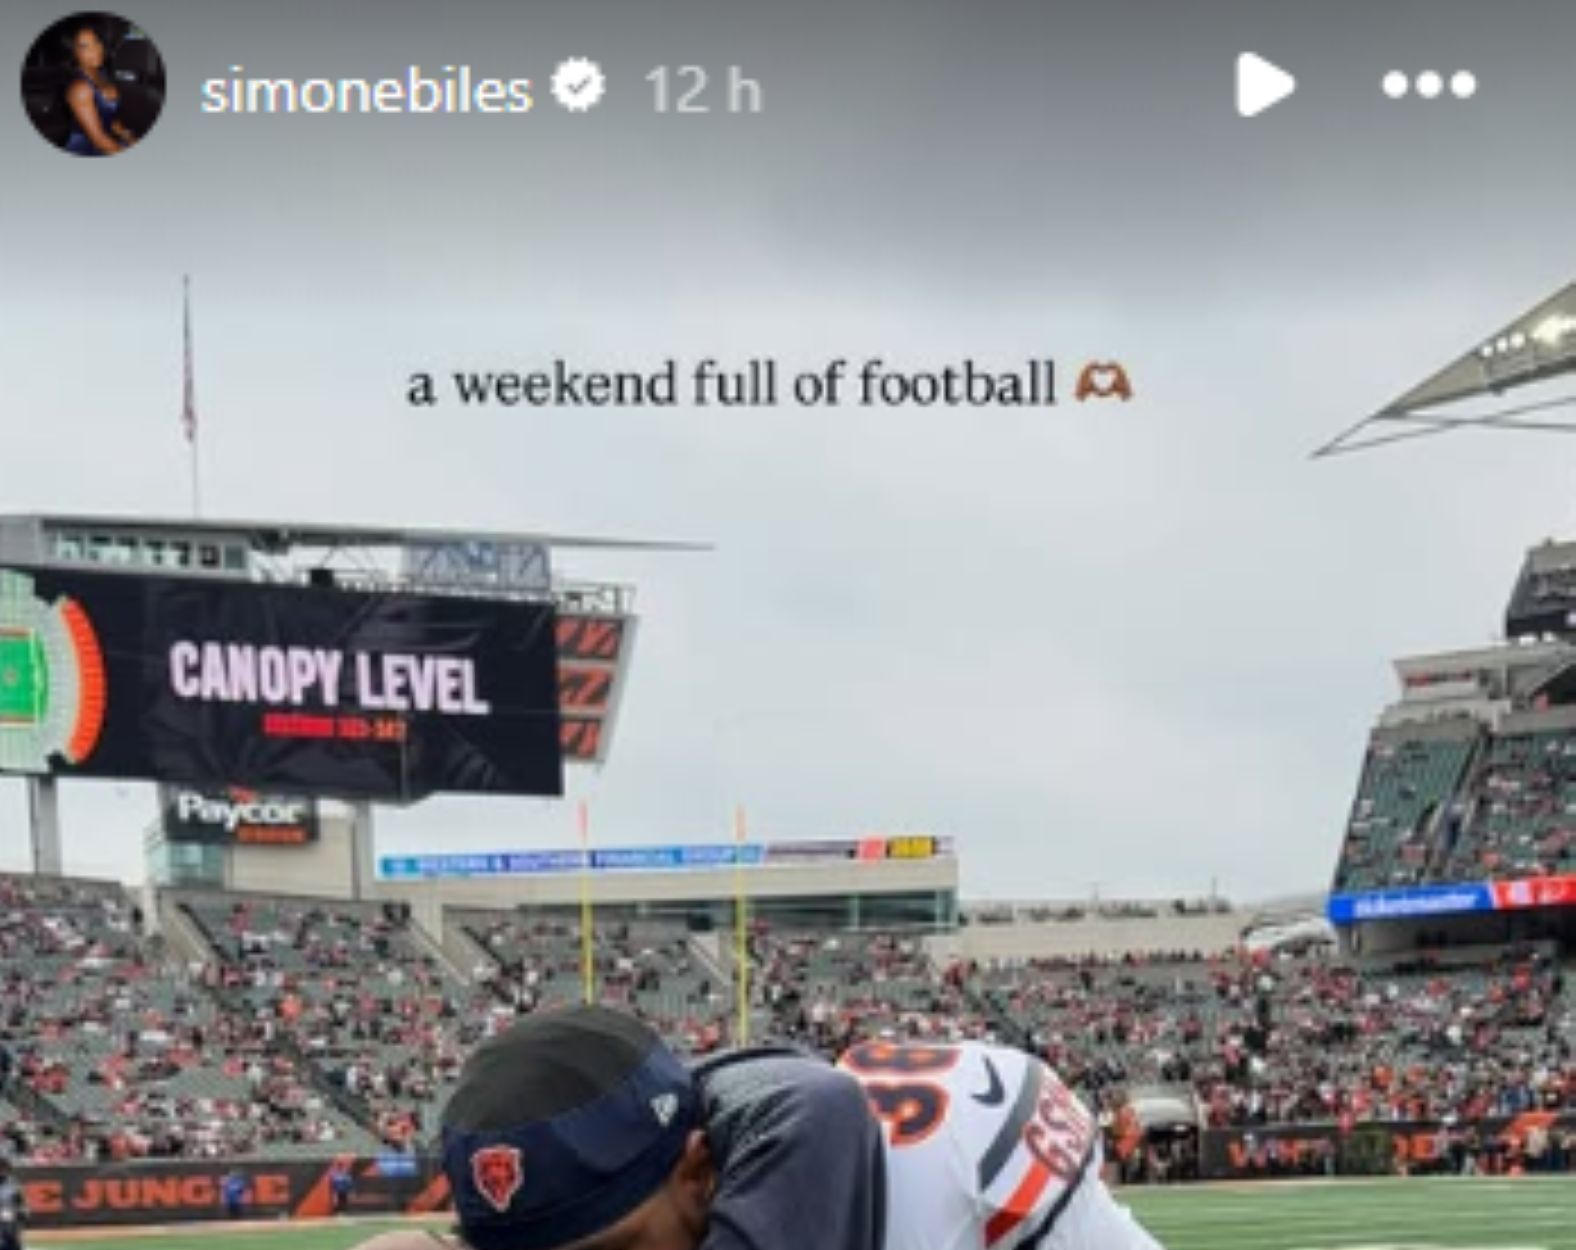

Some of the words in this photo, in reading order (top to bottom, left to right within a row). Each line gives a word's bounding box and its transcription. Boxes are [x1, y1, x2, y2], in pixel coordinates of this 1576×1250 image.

[170, 641, 343, 706] CANOPY
[356, 651, 490, 715] LEVEL
[177, 793, 305, 833] Paycor
